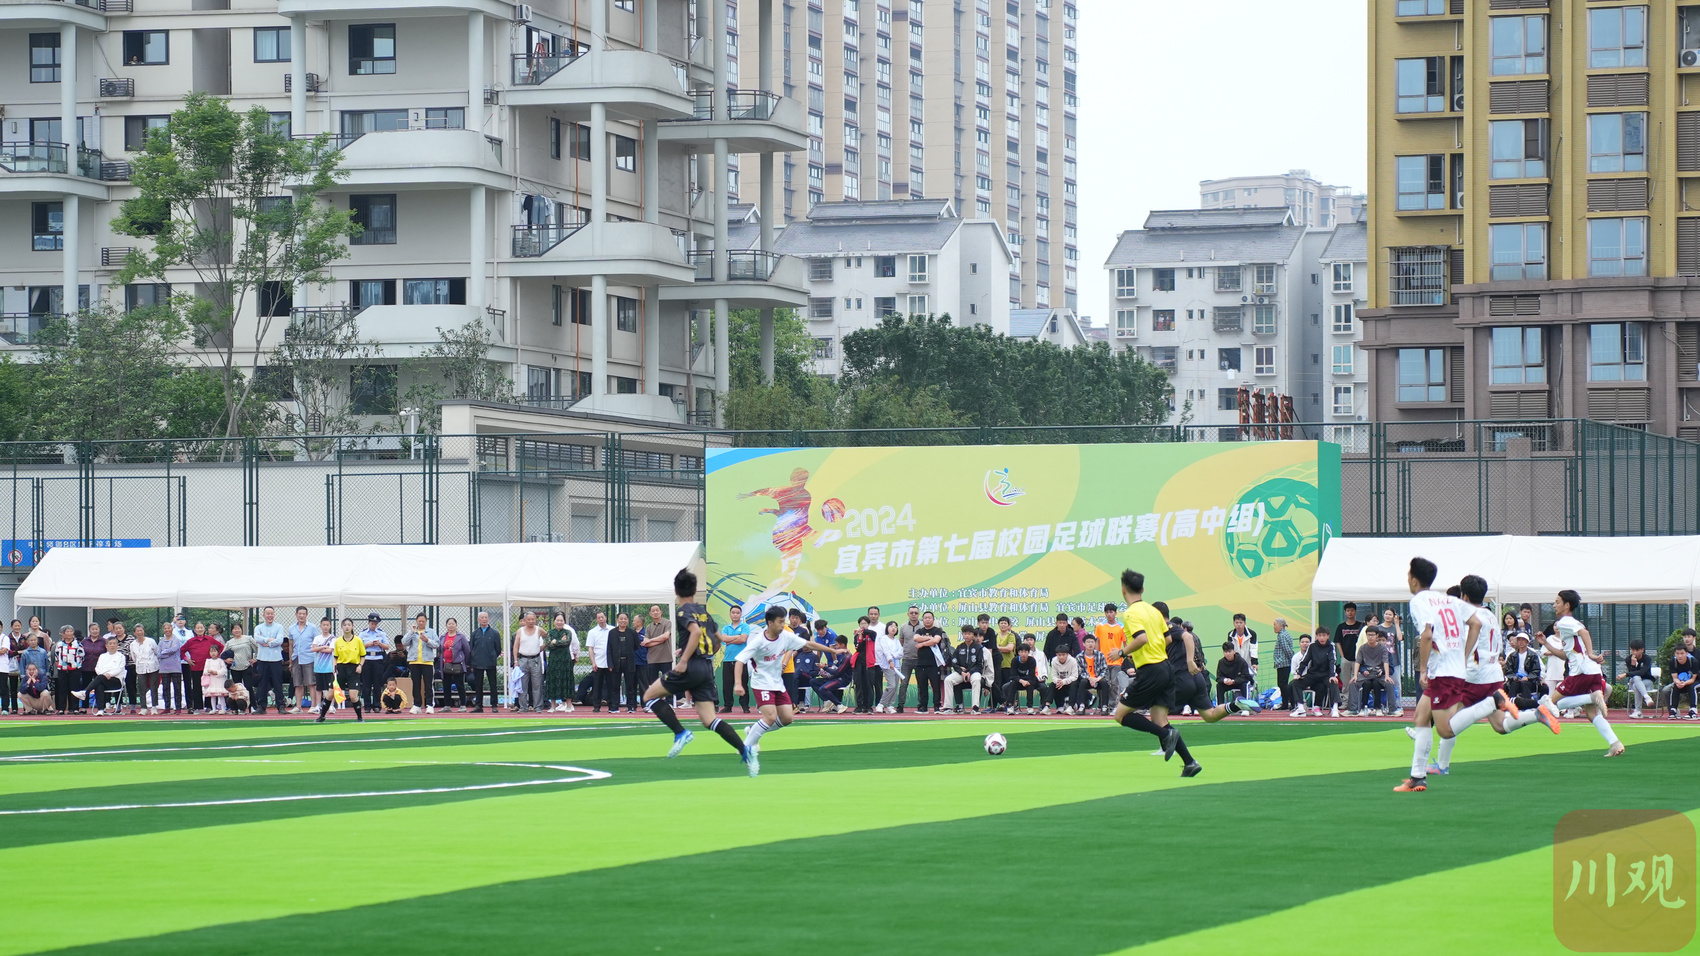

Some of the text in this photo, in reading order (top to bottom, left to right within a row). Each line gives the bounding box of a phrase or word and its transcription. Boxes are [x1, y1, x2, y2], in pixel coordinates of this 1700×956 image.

[844, 503, 917, 538] 2024
[834, 502, 1266, 575] 宜宾市第七届校园足球联赛(高中组)
[1056, 602, 1128, 613] 宜宾市足球会
[1438, 608, 1460, 640] 19
[761, 690, 771, 701] 15
